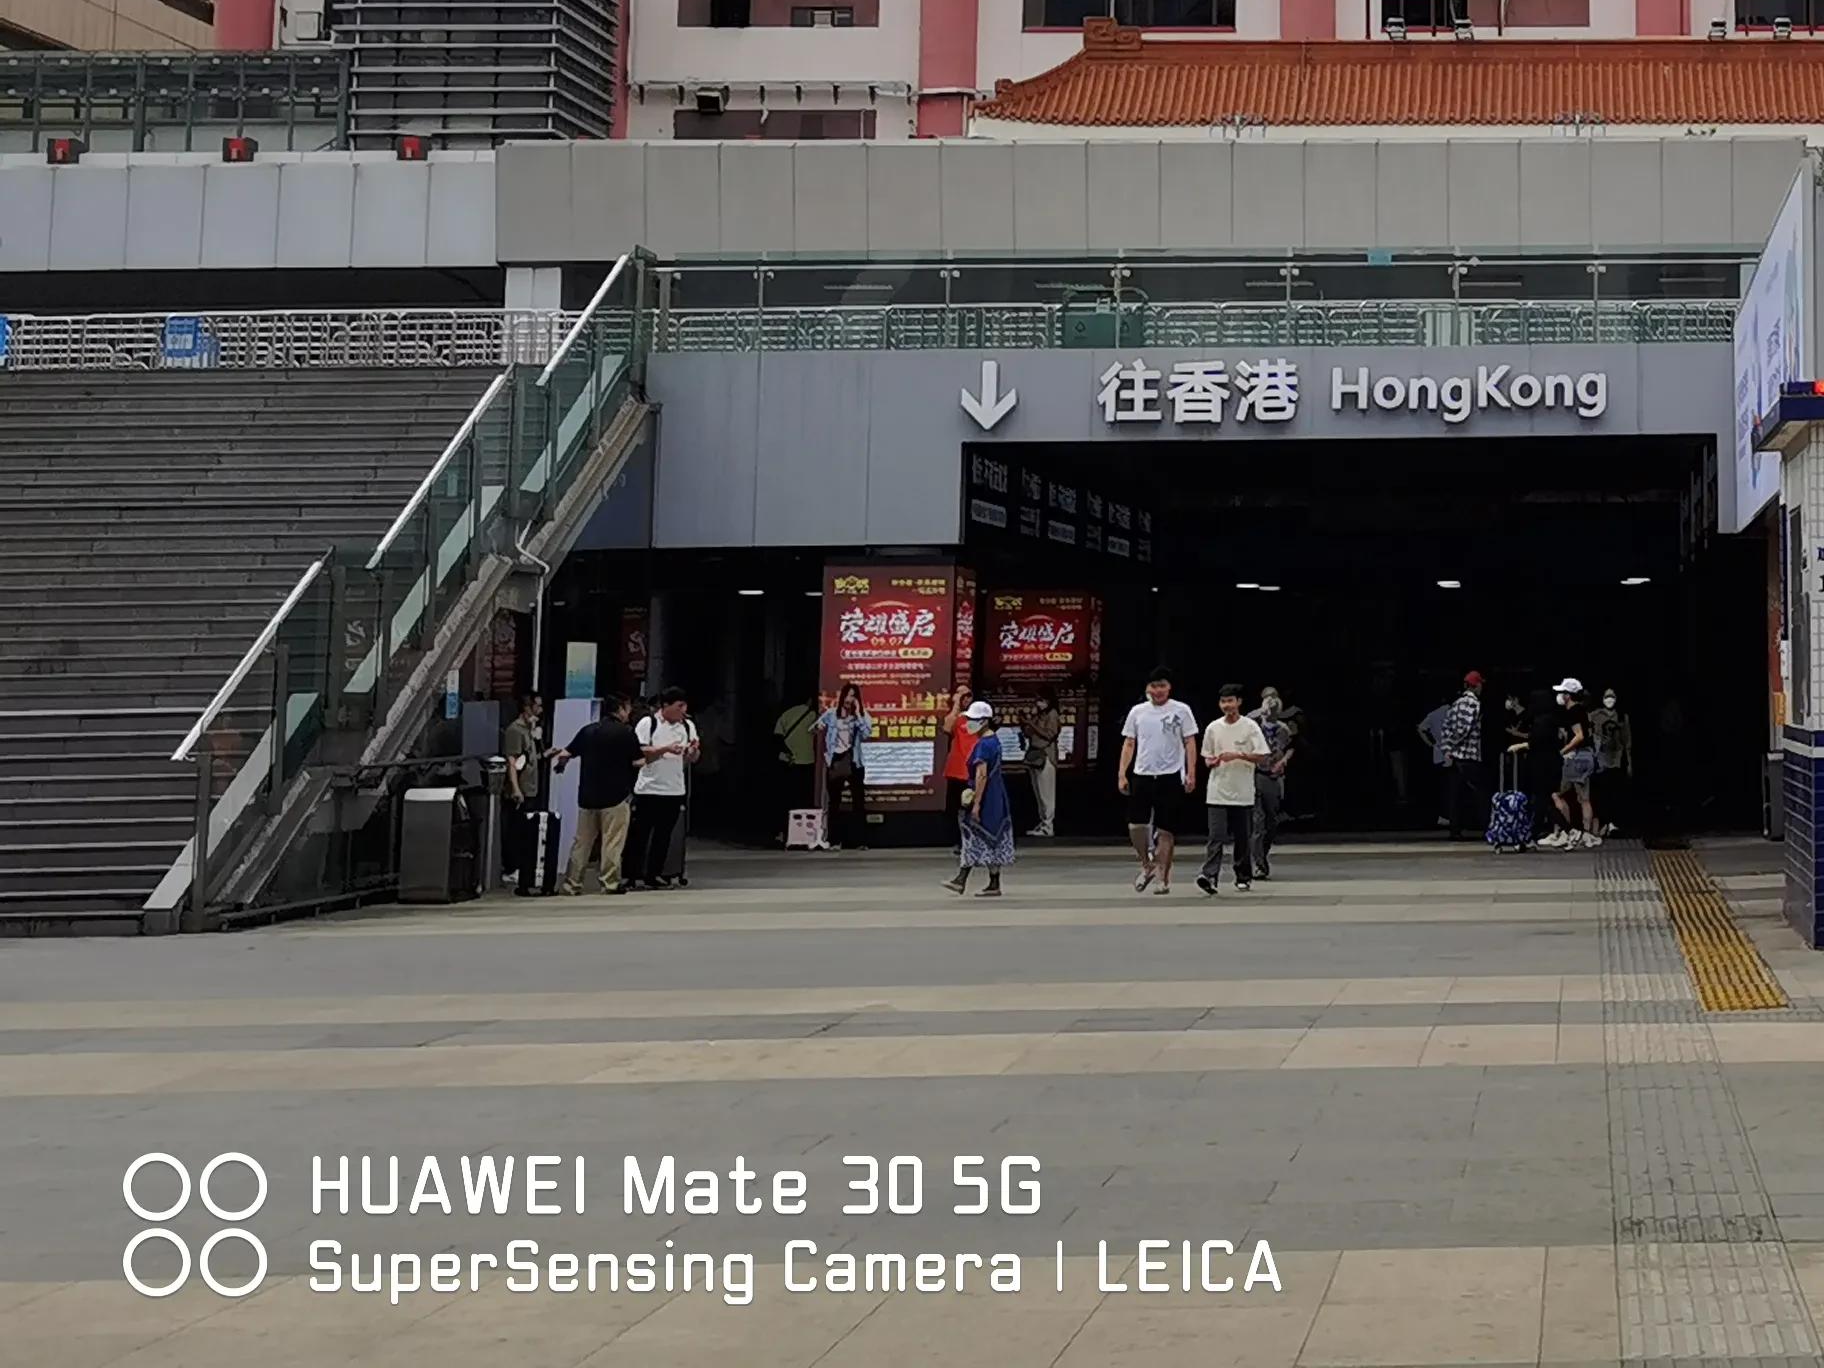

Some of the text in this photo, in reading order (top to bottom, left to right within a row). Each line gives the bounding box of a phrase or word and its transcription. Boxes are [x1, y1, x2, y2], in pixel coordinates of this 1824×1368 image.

[1097, 358, 1300, 423] 往香港
[1331, 364, 1608, 423] HongKong
